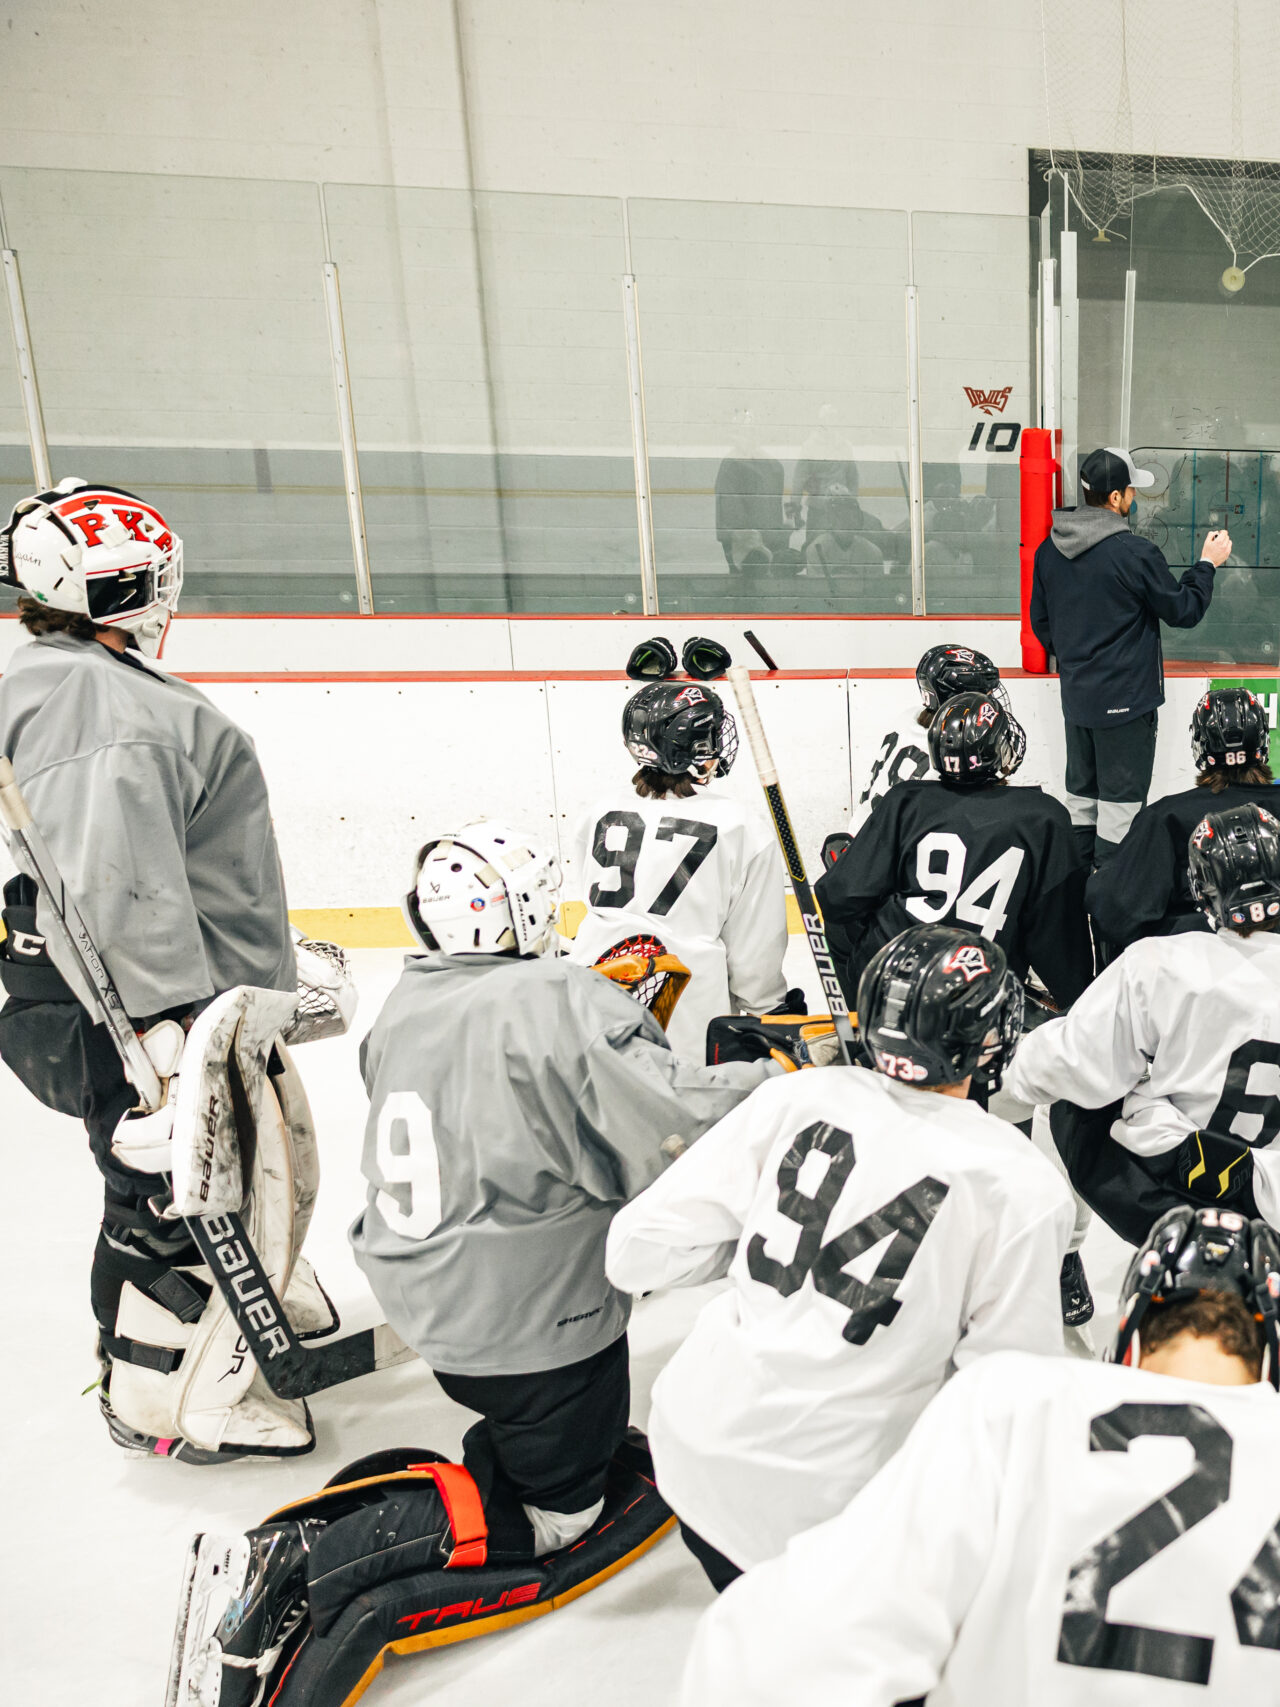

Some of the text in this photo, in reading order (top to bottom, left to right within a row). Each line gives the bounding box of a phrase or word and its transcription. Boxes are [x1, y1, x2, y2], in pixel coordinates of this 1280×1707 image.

[963, 386, 1013, 416] DEVILS
[968, 422, 1021, 452] 10
[944, 756, 960, 773] 17
[1225, 751, 1247, 766] 86
[589, 810, 718, 916] 97
[906, 832, 1024, 941] 94
[1250, 902, 1264, 923] 8
[803, 913, 849, 1017] BAUER
[881, 1052, 914, 1081] 73
[200, 1095, 219, 1203] BAUER
[375, 1090, 442, 1240] 9
[746, 1119, 950, 1346] 94
[200, 1213, 291, 1361] BAUER
[398, 1582, 542, 1632] TRUE
